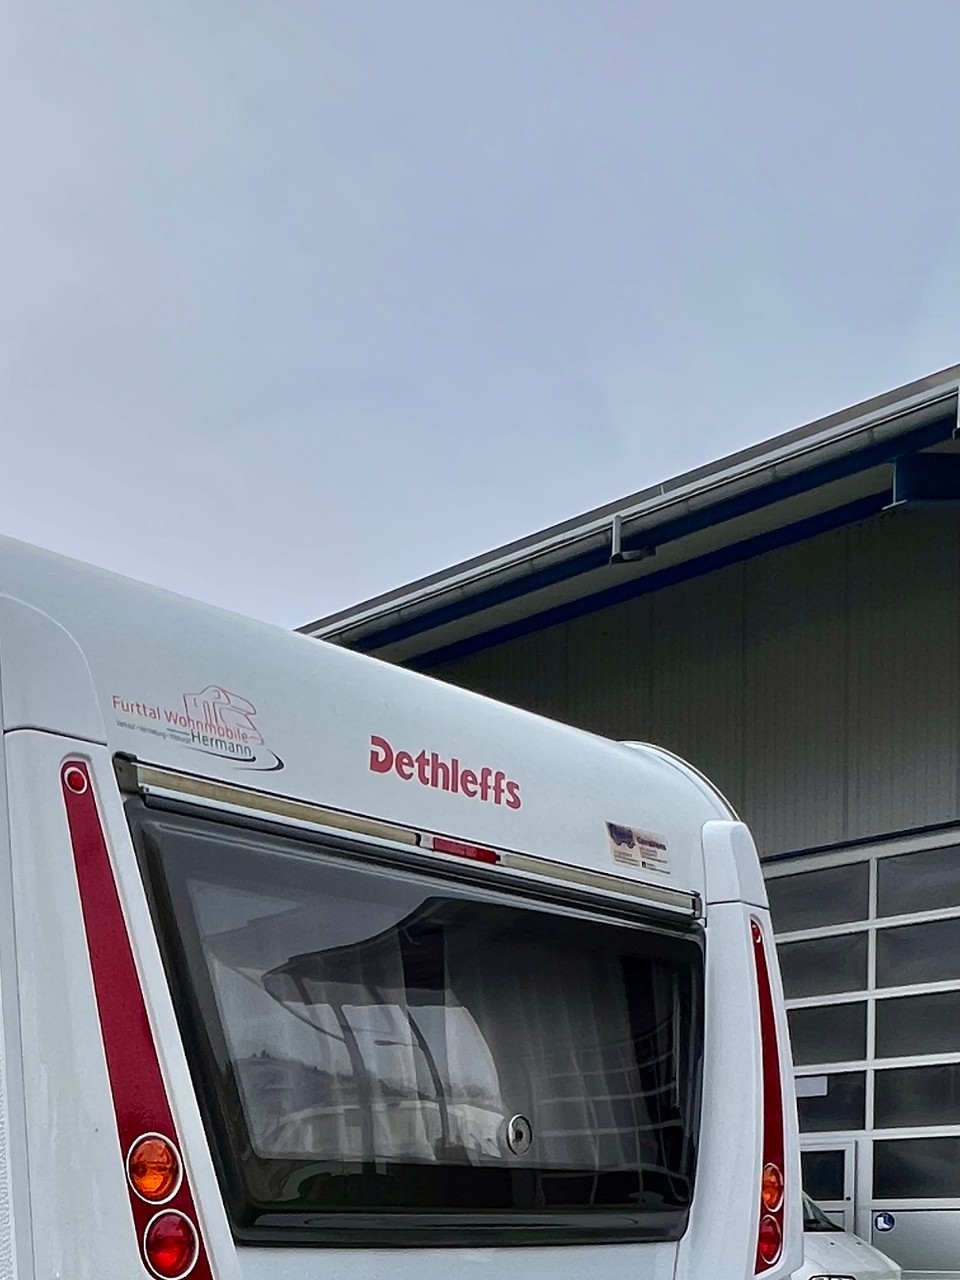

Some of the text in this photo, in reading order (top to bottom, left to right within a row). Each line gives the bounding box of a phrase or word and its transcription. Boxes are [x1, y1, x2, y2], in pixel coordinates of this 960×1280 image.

[111, 695, 160, 721] Furttal
[164, 709, 249, 743] Wohnmobile
[191, 729, 252, 757] Hermann
[369, 735, 522, 810] Dethleffs
